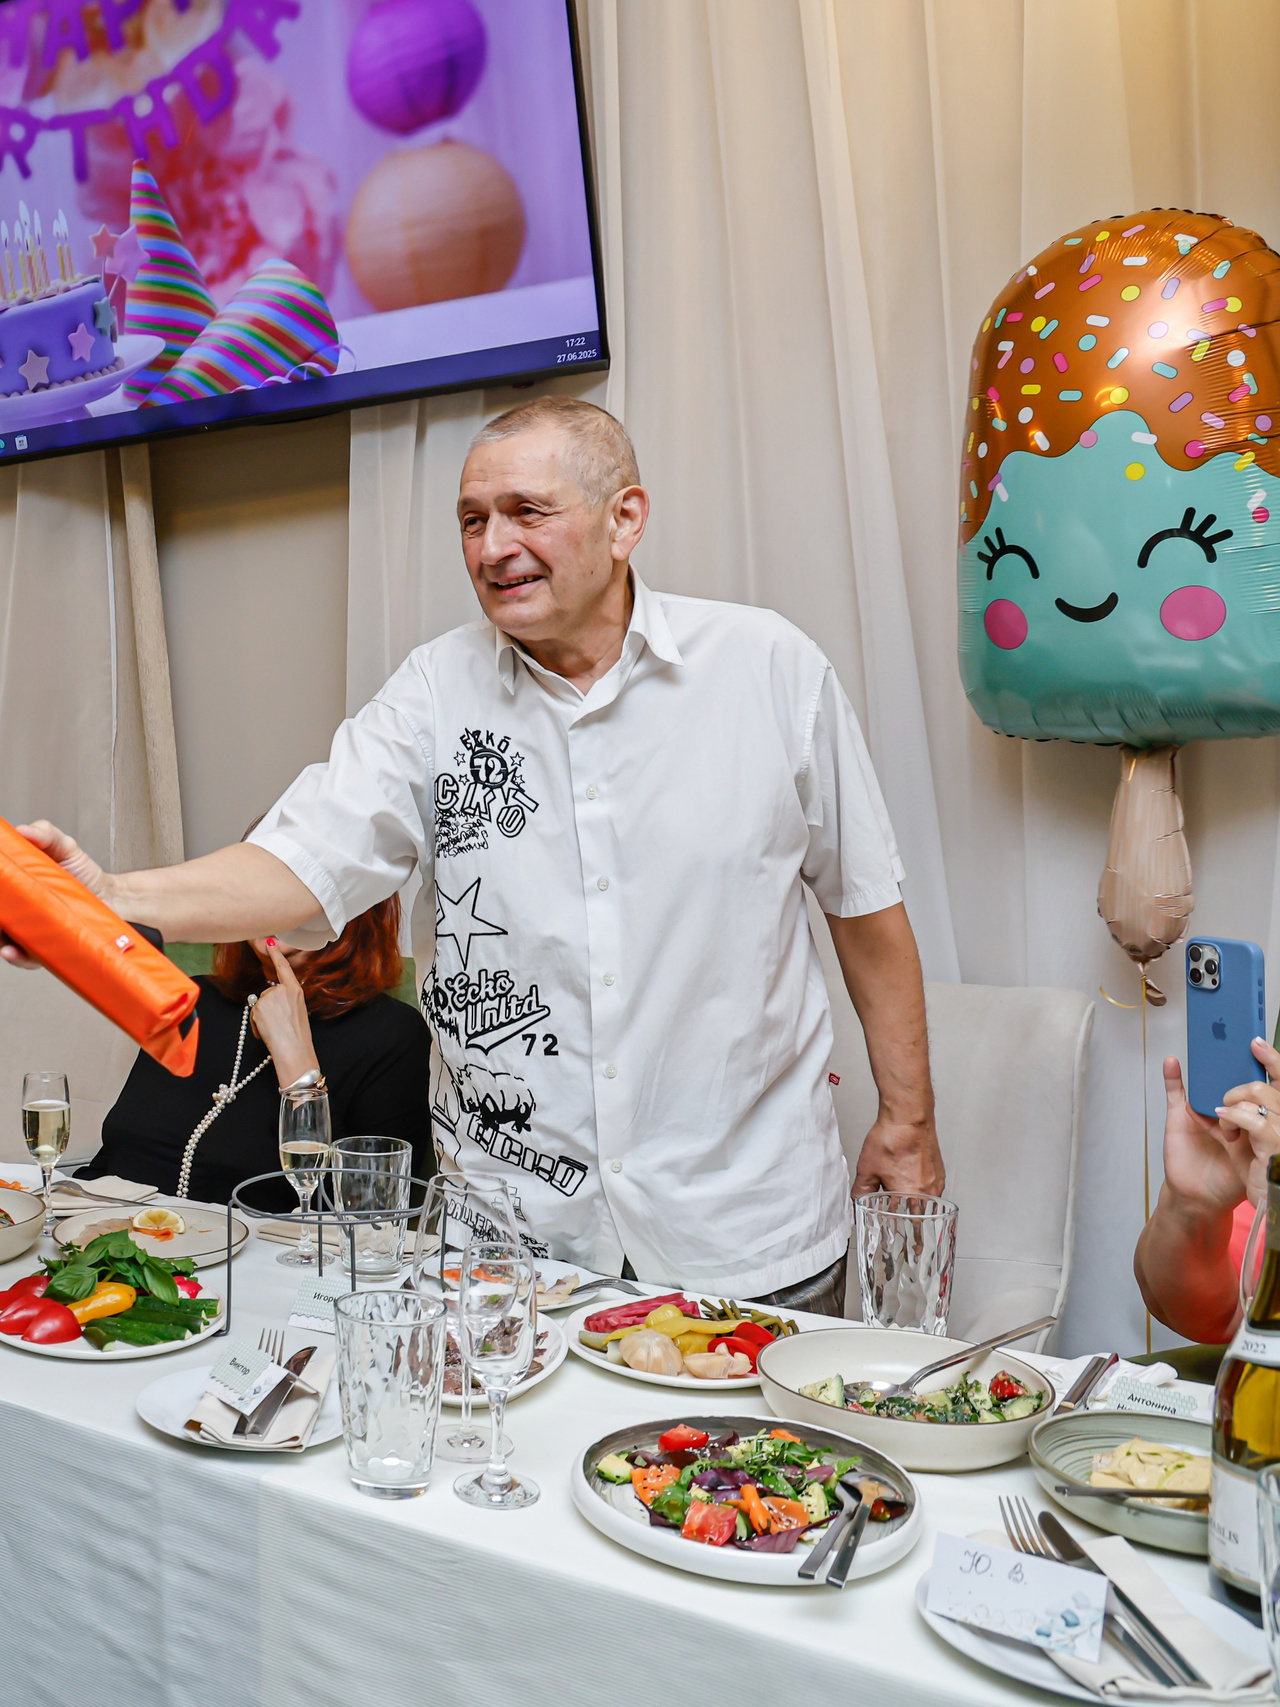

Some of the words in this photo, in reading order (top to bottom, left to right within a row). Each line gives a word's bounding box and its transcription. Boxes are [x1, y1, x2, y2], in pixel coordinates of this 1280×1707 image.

[565, 336, 586, 347] 17:22
[556, 348, 598, 363] 27.06.2025
[472, 755, 503, 785] 72
[521, 1033, 559, 1056] 72
[1241, 1339, 1267, 1354] 2022
[229, 1357, 251, 1376] Виктор
[1127, 1393, 1178, 1415] Антонина
